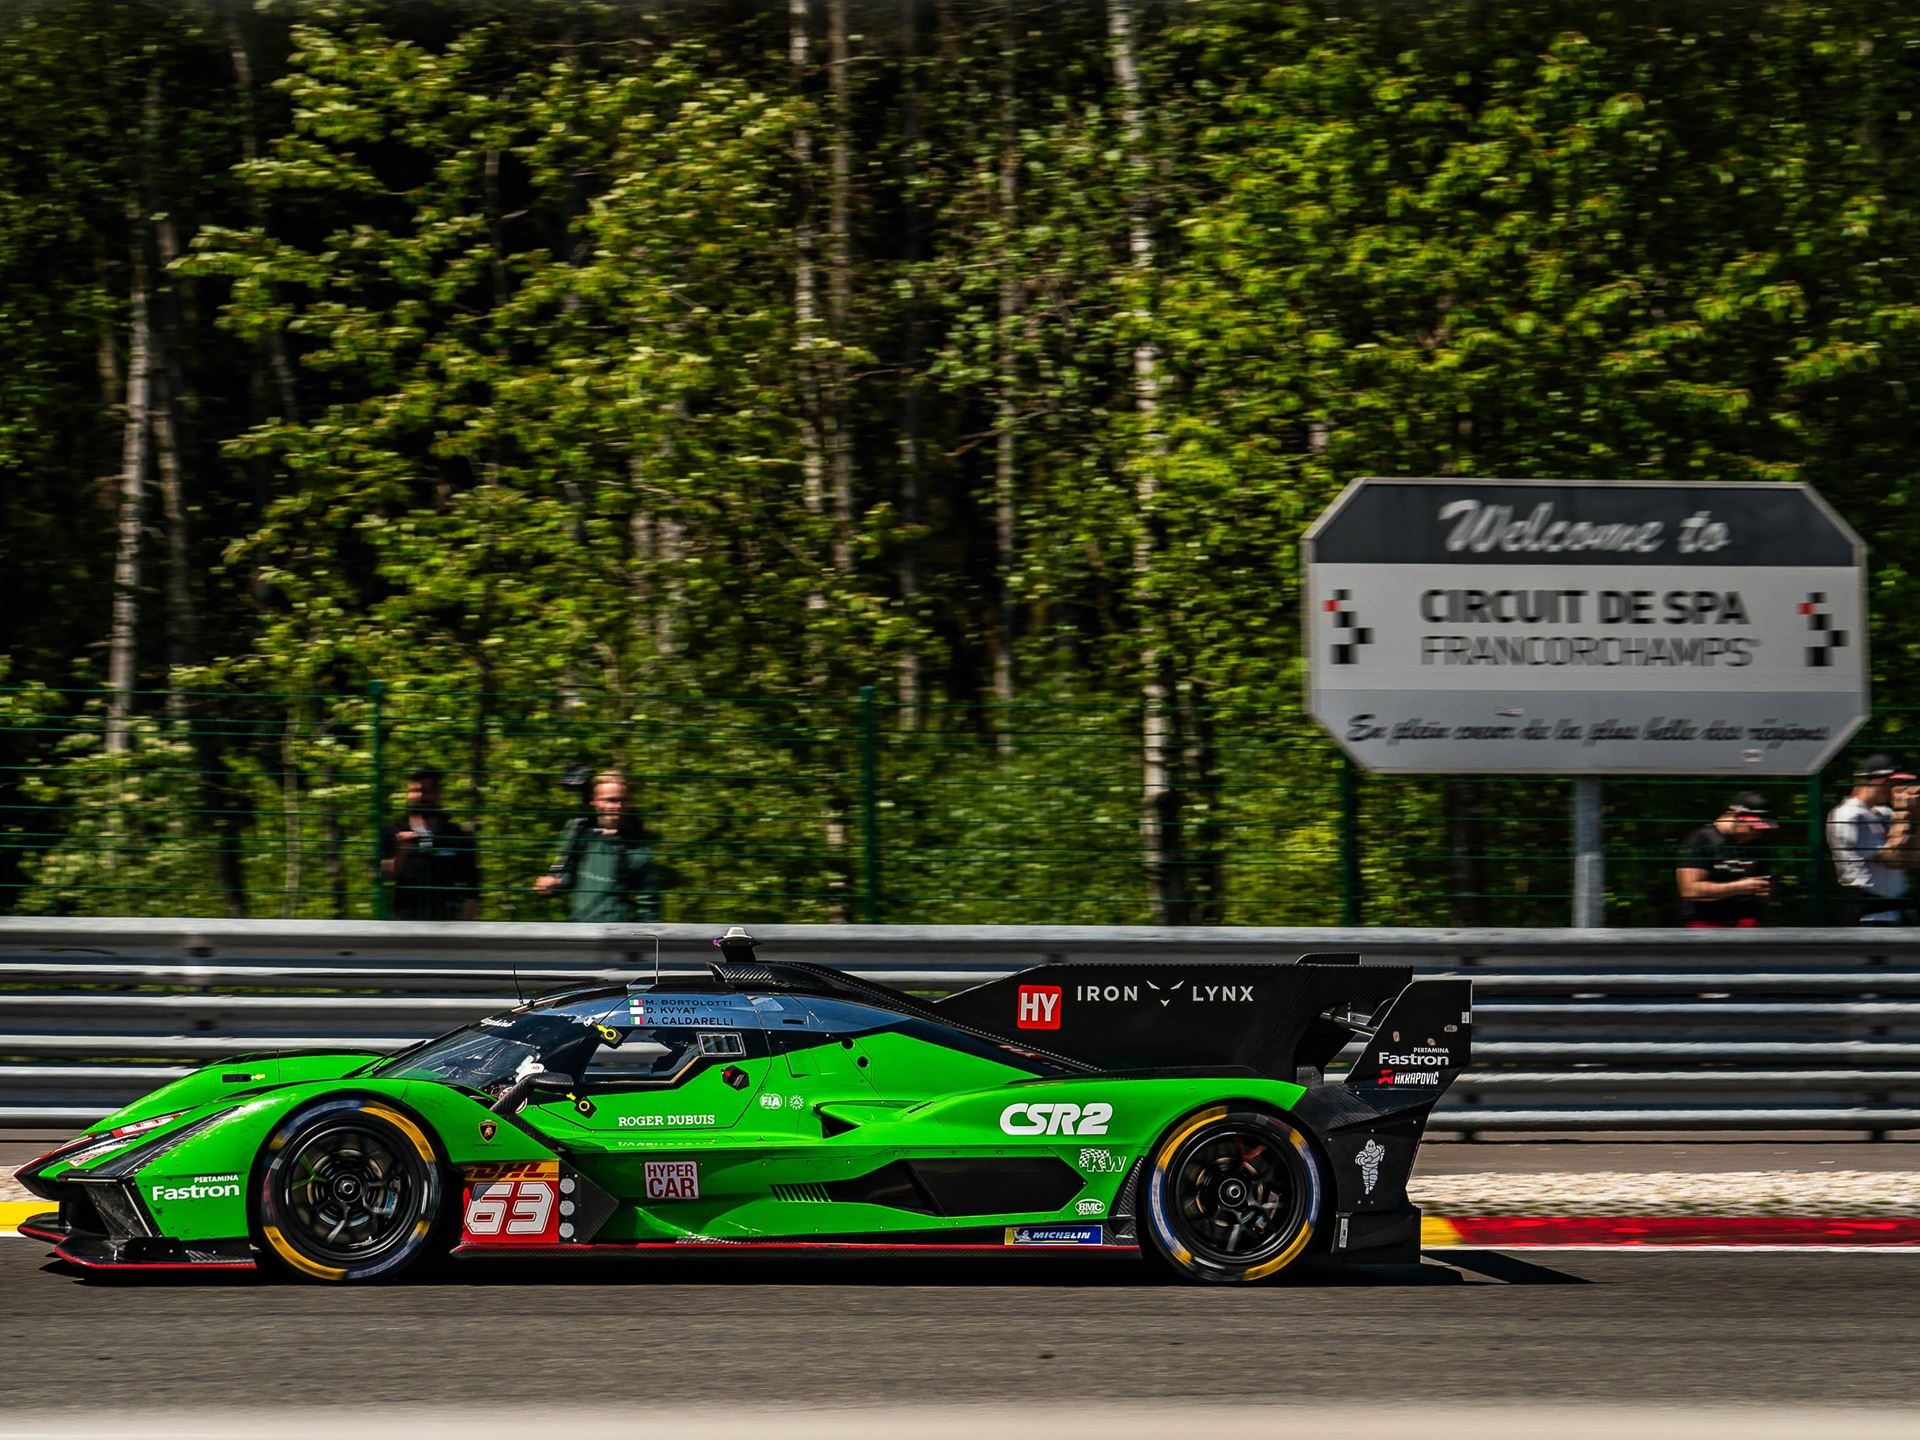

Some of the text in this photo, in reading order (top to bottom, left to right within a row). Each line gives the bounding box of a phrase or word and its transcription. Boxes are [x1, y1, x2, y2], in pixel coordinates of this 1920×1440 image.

[1438, 499, 1731, 553] Welcome to
[1419, 589, 1752, 625] CIRCUIT DE SPA
[1420, 636, 1755, 667] FRANCORCHAMPS
[1077, 985, 1254, 1002] IRON LYNX
[661, 999, 732, 1007] BORTOLOTTI
[1020, 992, 1058, 1022] HY
[661, 1007, 697, 1015] KVYAT
[647, 1016, 734, 1026] A. CALDARELLI
[1378, 1052, 1450, 1066] Fastron
[760, 1094, 781, 1107] FIA
[618, 1114, 715, 1127] ROGER DUBUIS
[1000, 1103, 1113, 1135] CSR2
[647, 1164, 694, 1177] HYPER
[1087, 1155, 1127, 1172] KW
[194, 1174, 239, 1183] PERTAMINA
[152, 1184, 240, 1201] Fastron
[648, 1177, 696, 1198] CAR
[464, 1182, 555, 1235] 63
[1078, 1202, 1103, 1211] BMC
[1032, 1231, 1091, 1239] MICHELIN
